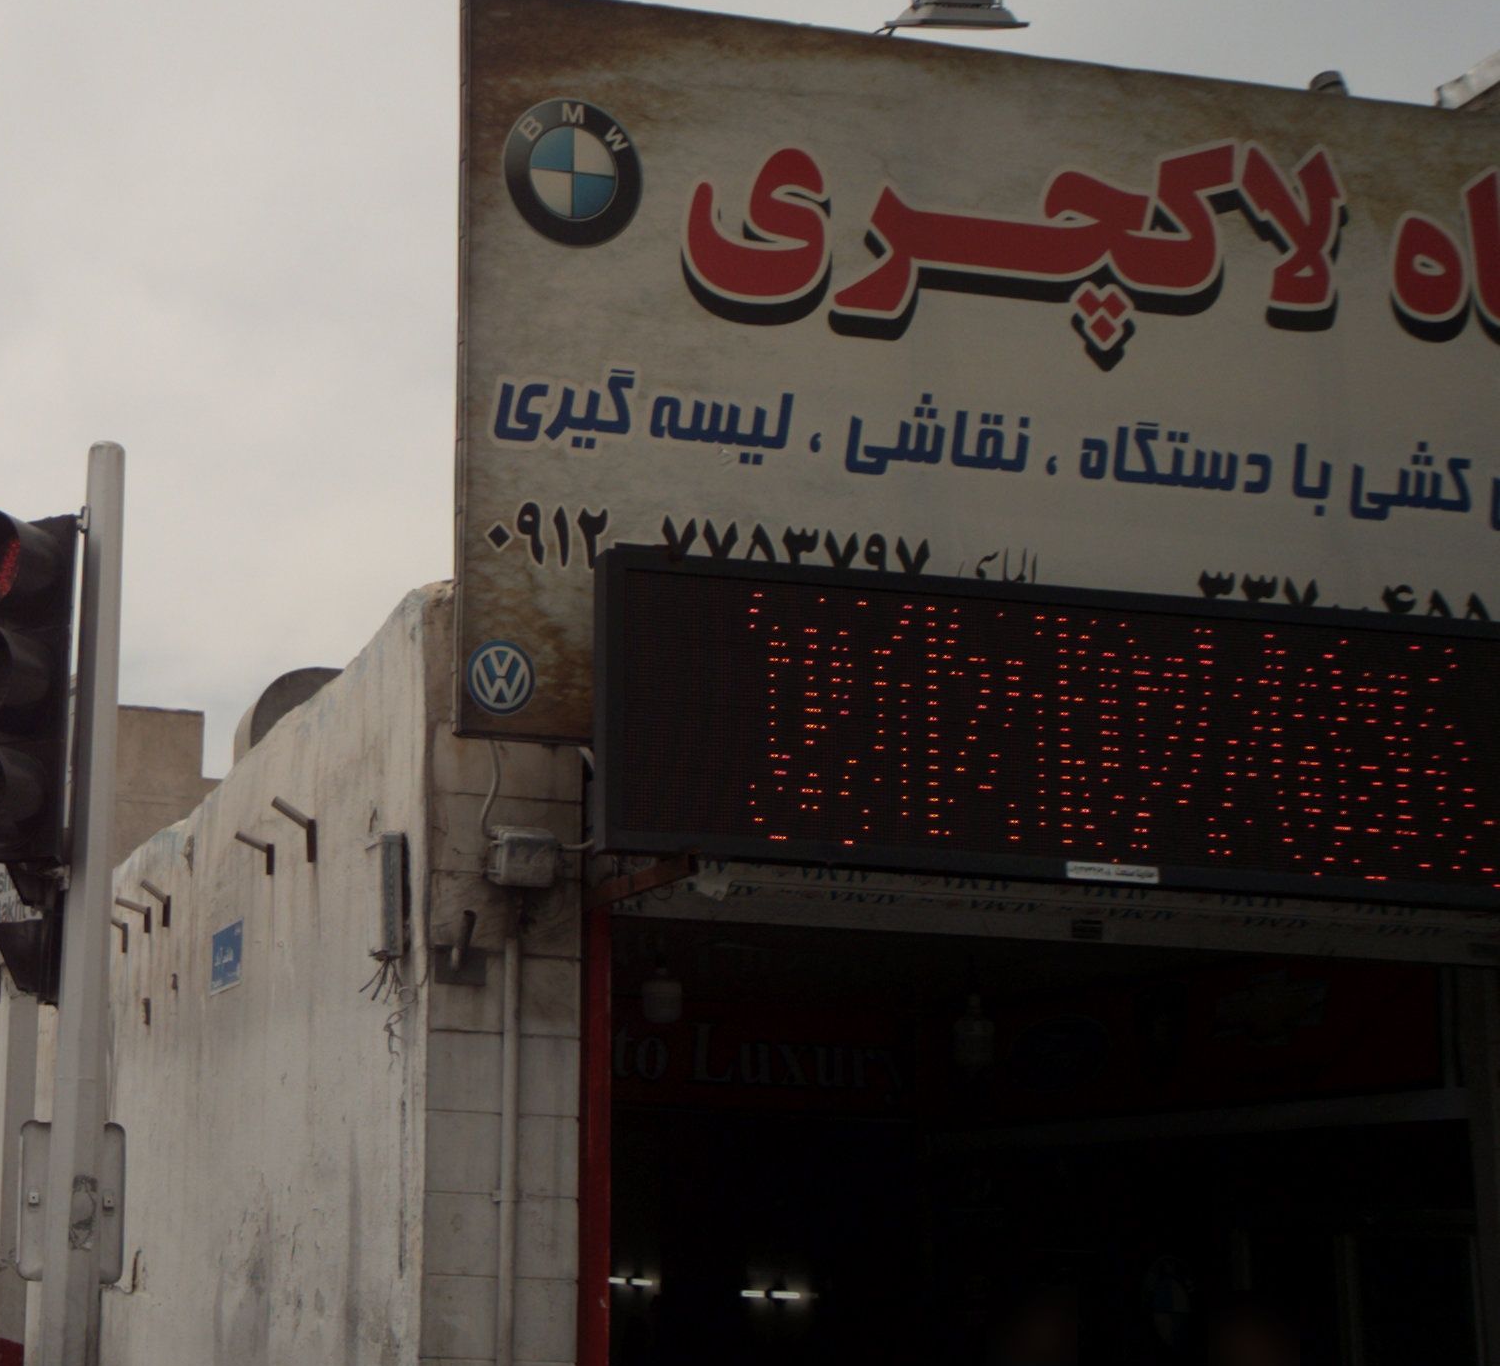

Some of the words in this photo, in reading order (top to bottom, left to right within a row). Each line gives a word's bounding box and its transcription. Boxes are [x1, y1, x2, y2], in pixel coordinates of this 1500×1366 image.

[518, 101, 629, 153] BMW
[684, 141, 1342, 363] لاکچری
[493, 370, 636, 446] گیری
[649, 392, 795, 463] لیسه
[844, 392, 1031, 475] نقاشی
[1080, 421, 1272, 492] دستگاه
[1292, 442, 1334, 512] با
[487, 499, 610, 571] ۰۹۱۲
[689, 1019, 904, 1105] Luxury
